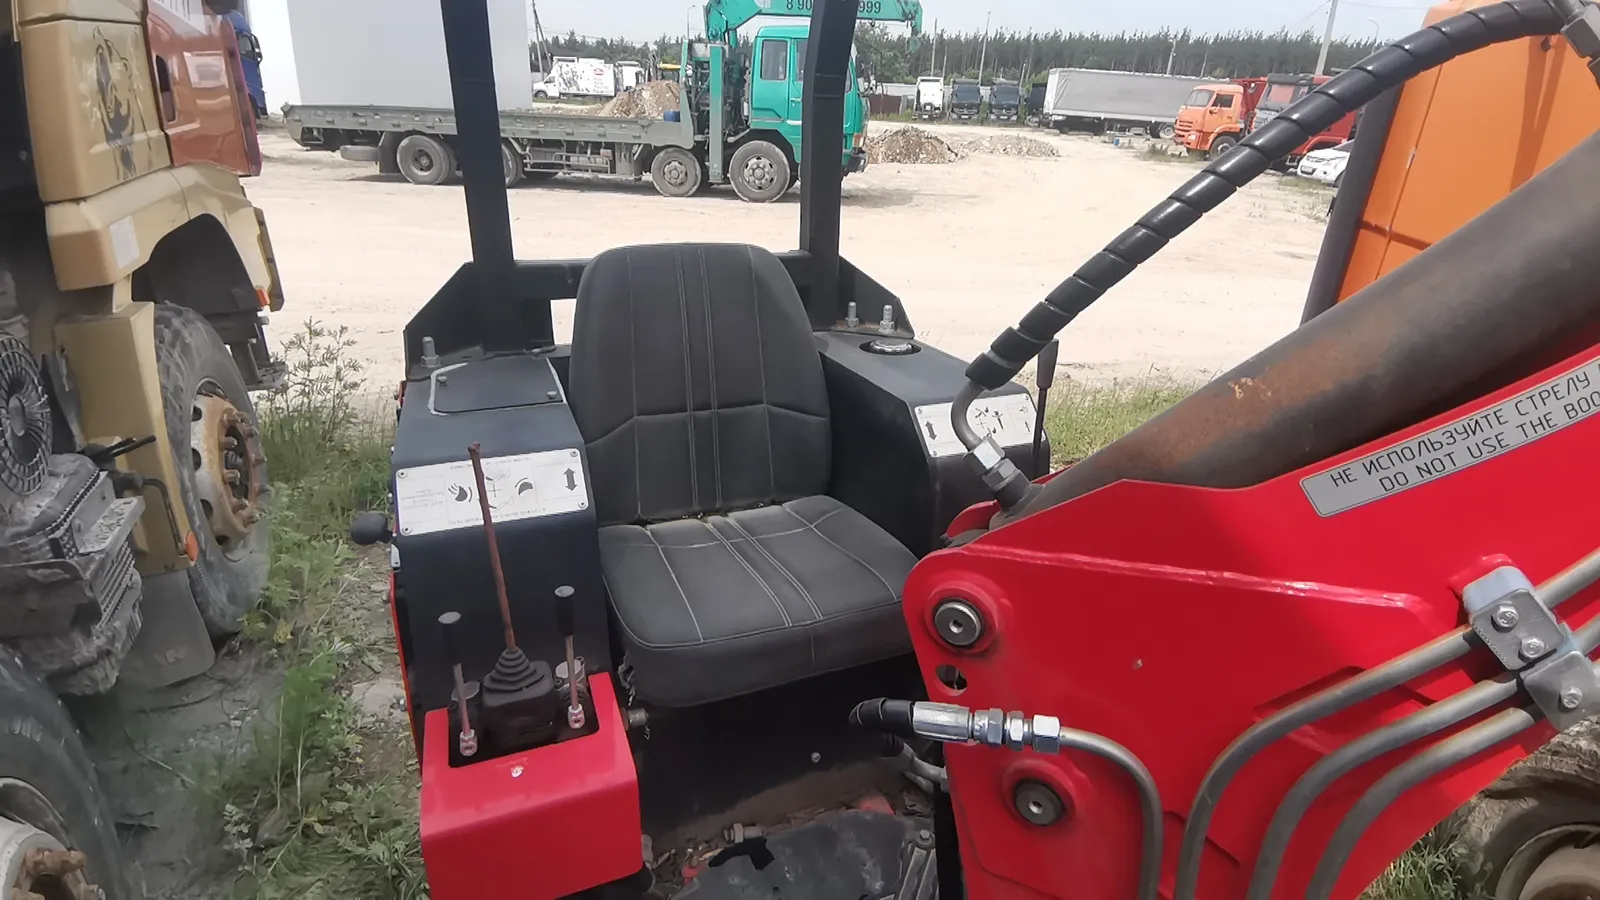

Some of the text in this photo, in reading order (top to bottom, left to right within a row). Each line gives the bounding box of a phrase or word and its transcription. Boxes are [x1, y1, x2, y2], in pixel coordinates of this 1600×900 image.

[1330, 371, 1591, 488] НЕ ИСПОЛЬЗУЙТЕ СТРЕЛУ
[1379, 471, 1409, 492] DO
[1415, 451, 1457, 479] NOT
[1466, 431, 1510, 459] USE
[1516, 411, 1558, 439] THE
